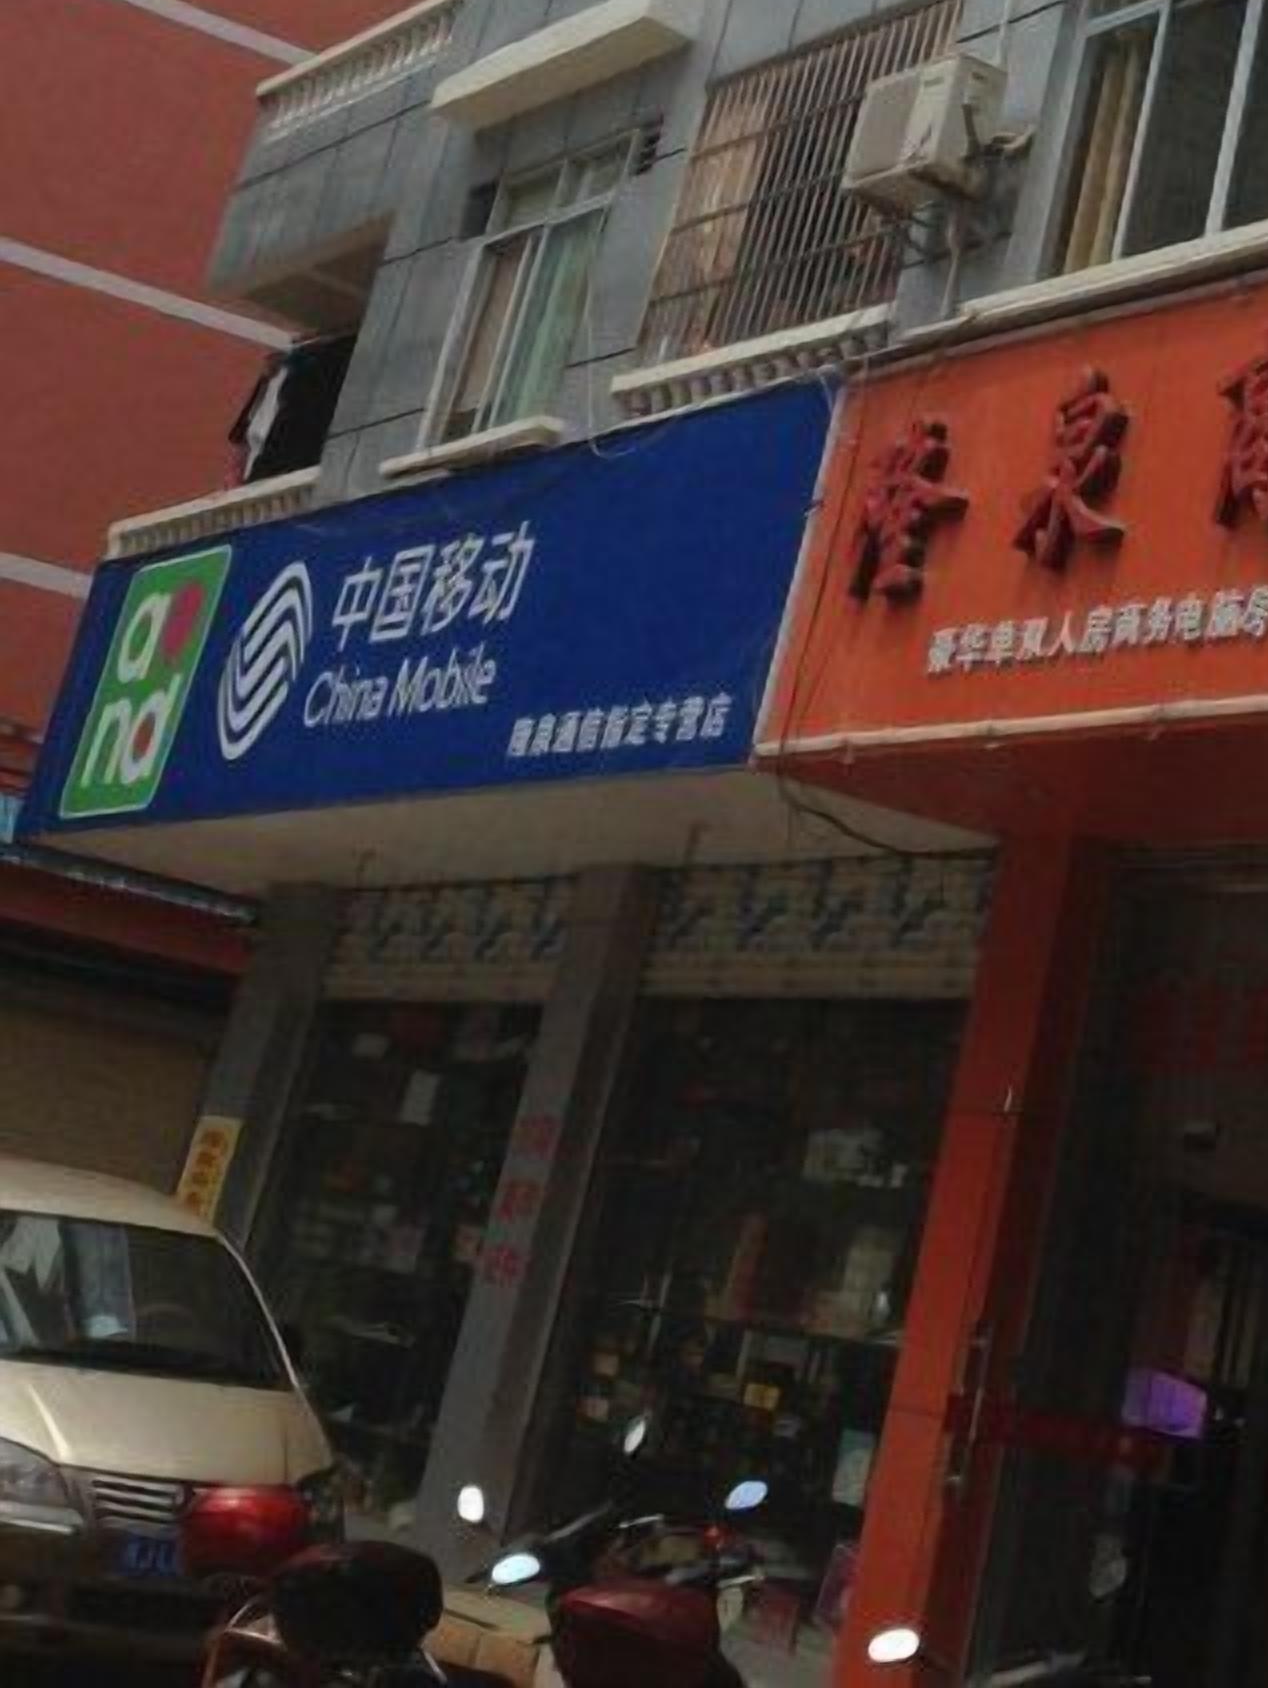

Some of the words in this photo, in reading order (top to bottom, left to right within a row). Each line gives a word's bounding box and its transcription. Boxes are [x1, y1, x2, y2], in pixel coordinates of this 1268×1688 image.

[332, 520, 536, 653] 中国移动
[303, 667, 389, 728] China
[387, 642, 497, 717] Mobile
